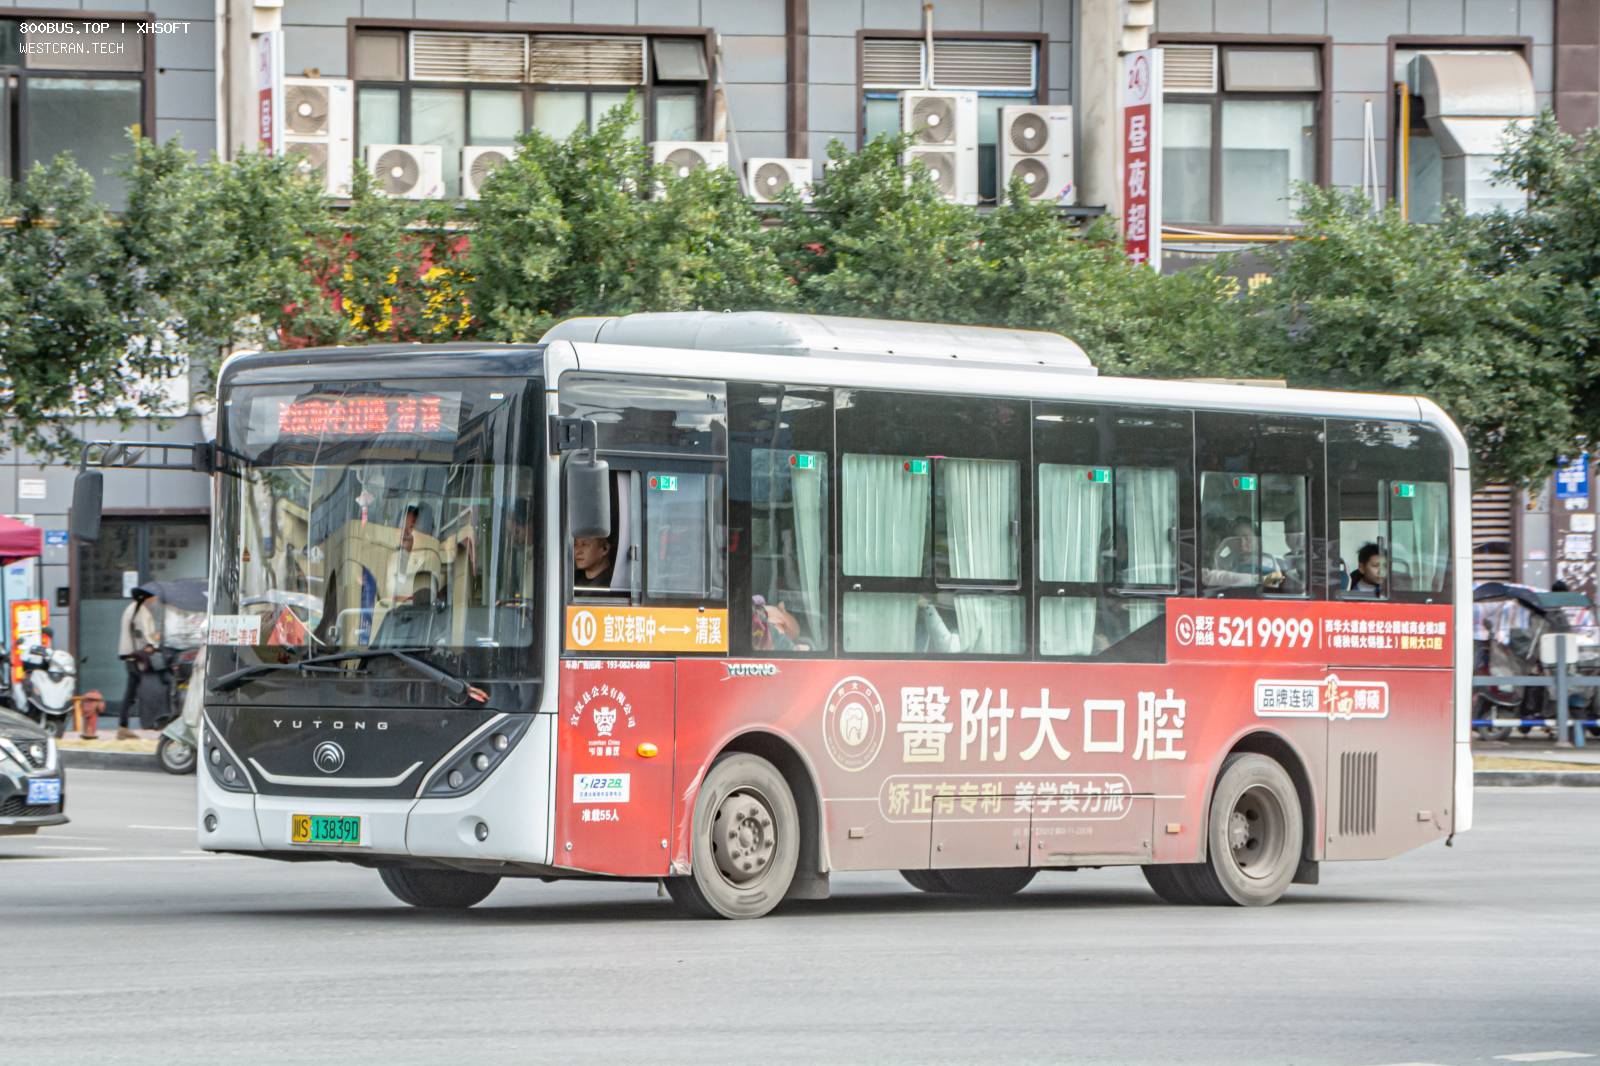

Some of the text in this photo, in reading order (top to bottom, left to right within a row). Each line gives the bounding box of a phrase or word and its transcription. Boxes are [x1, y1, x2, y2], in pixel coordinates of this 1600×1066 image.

[574, 613, 593, 642] 10
[603, 614, 722, 645] 宣汉老职中 清溪
[727, 663, 778, 677] YUTONG
[1262, 688, 1315, 709] 品牌连锁
[272, 719, 389, 731] YUTONG
[896, 685, 1188, 763] 醫附大口腔
[590, 778, 623, 789] 12328
[888, 780, 1125, 815] 矫正有专利 美学实力派
